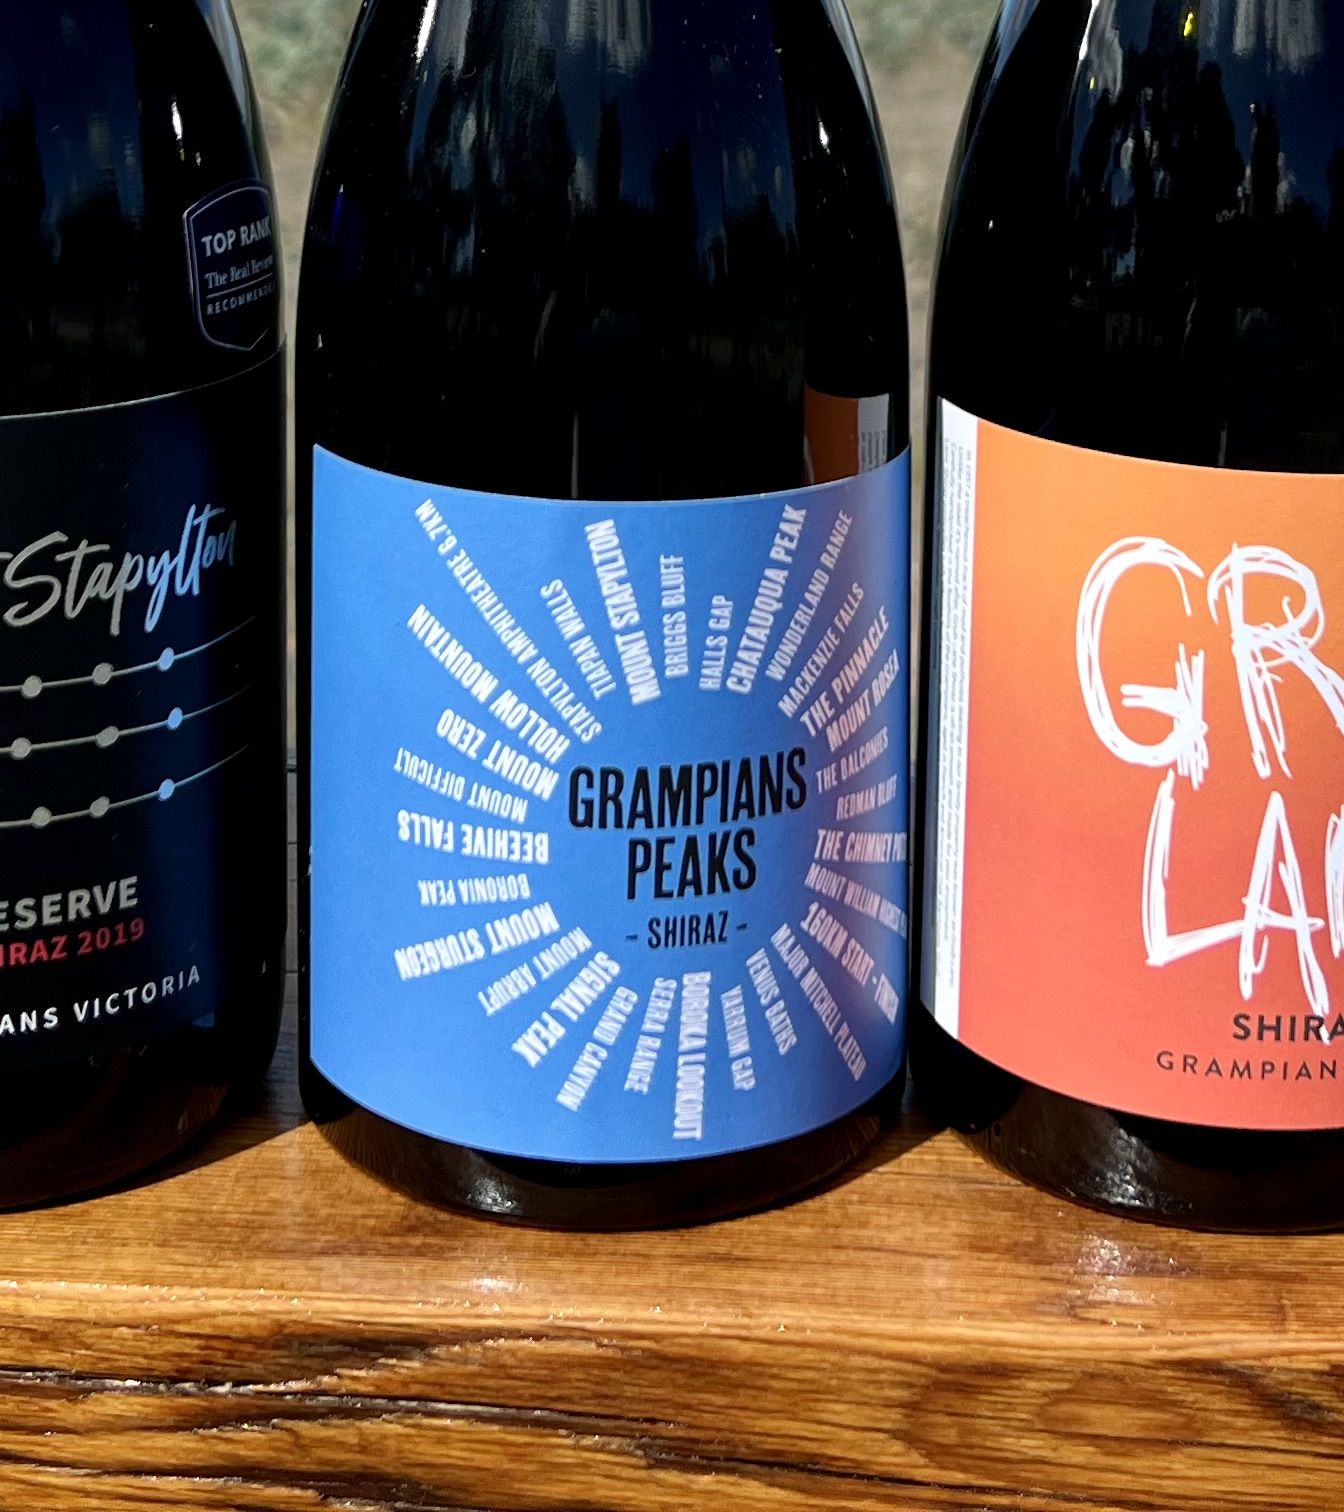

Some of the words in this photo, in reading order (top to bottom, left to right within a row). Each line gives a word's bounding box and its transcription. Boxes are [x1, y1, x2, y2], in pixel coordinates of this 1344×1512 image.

[201, 229, 236, 257] TOP
[204, 271, 229, 288] The
[2, 503, 238, 638] Stapylton
[584, 519, 641, 631] STAPYLTON
[659, 554, 686, 608] BLUFF
[726, 567, 789, 695] CHATAUQUA
[769, 504, 806, 564] PEAK
[764, 568, 830, 682] WONDERLAND
[819, 509, 853, 571] RANGE
[447, 549, 539, 664] AMPHITHEATRE
[540, 579, 586, 640] WALLS
[708, 594, 734, 631] GAP
[407, 603, 499, 704] MOUNTAIN
[568, 635, 617, 701] TIAPAN
[614, 630, 661, 706] MOUNT
[661, 611, 690, 679] BRIGGS
[698, 635, 728, 691] HALLS
[777, 628, 841, 719] MACKENZIE
[834, 581, 864, 634] FALLS
[800, 691, 835, 734] THE
[831, 605, 889, 704] PINNACLE
[489, 689, 571, 764] HOLLOW
[527, 657, 602, 743] STAPYLTON
[825, 688, 872, 752] MOUNT
[436, 708, 487, 760] ZERO
[393, 747, 466, 802] DIFFICULT
[481, 740, 560, 802] MOUNT
[568, 746, 807, 830] GRAMPIANS
[815, 768, 839, 793] THE
[397, 809, 455, 853] FALLS
[467, 782, 529, 825] MOUNT
[836, 787, 877, 822] REDMAN
[460, 823, 549, 865] BEEHIVE
[627, 826, 757, 901] PEAKS
[814, 828, 845, 862] THE
[417, 879, 457, 906] PEAK
[457, 873, 531, 905] BORONIA
[805, 862, 847, 902] MOUNT
[77, 916, 146, 956] 2019
[394, 928, 486, 981] STURGEON
[484, 901, 560, 956] MOUNT
[532, 926, 592, 981] MOUNT
[647, 909, 729, 950] SHIRAZ
[800, 901, 849, 959] 160KM
[841, 938, 876, 987] START
[73, 964, 201, 1024] VICTORIA
[478, 963, 537, 1017] ABRUPT
[550, 951, 621, 1022] SIGNAL
[592, 986, 638, 1046] GRAND
[746, 947, 780, 1006] VENUS
[765, 999, 798, 1056] BATHS
[771, 922, 810, 980] MAJOR
[800, 966, 842, 1037] MITCHELL
[834, 1021, 868, 1082] PLATEAU
[511, 1011, 566, 1068] PEAK
[624, 1035, 661, 1095] RANGE
[556, 1041, 608, 1112] CANYON
[731, 1056, 756, 1091] GAP
